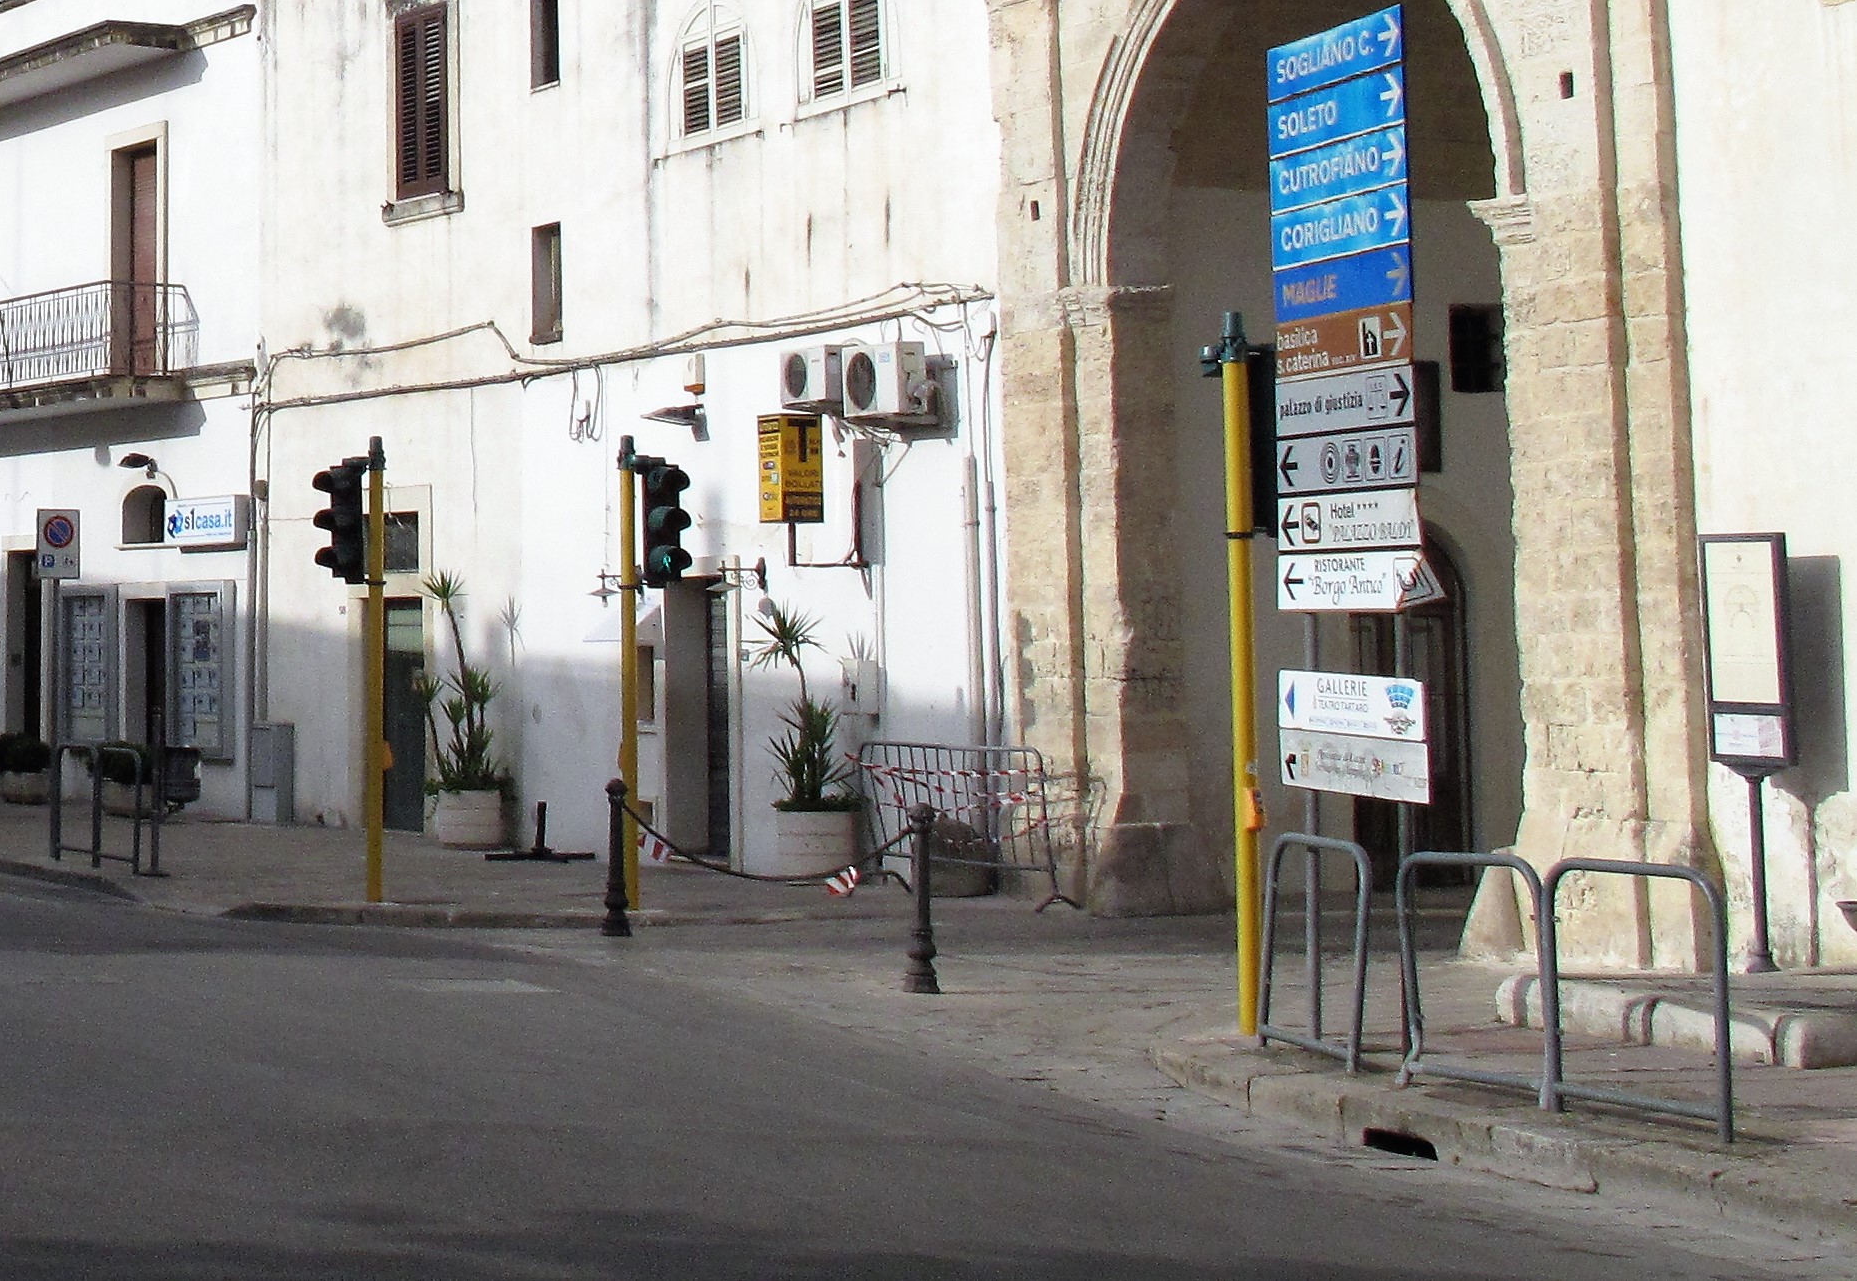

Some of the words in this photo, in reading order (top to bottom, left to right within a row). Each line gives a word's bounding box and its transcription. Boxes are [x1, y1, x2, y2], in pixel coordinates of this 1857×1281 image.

[1276, 37, 1355, 84] SOGLIANO
[1358, 30, 1374, 55] C.
[1277, 101, 1338, 140] SOLETO
[1279, 146, 1380, 195] CUTROFIANO
[1280, 206, 1379, 252] CORIGLIANO
[1282, 274, 1339, 309] MAGLIE
[1277, 326, 1318, 351] basilica
[1286, 348, 1329, 373] caterina
[1280, 398, 1312, 420] palazzo
[1314, 395, 1322, 413] di
[1325, 391, 1363, 415] giustizia
[787, 419, 817, 463] T
[1330, 502, 1355, 519] Hotel
[1314, 558, 1365, 572] RISTORANTE
[1316, 677, 1368, 697] GALLERIE
